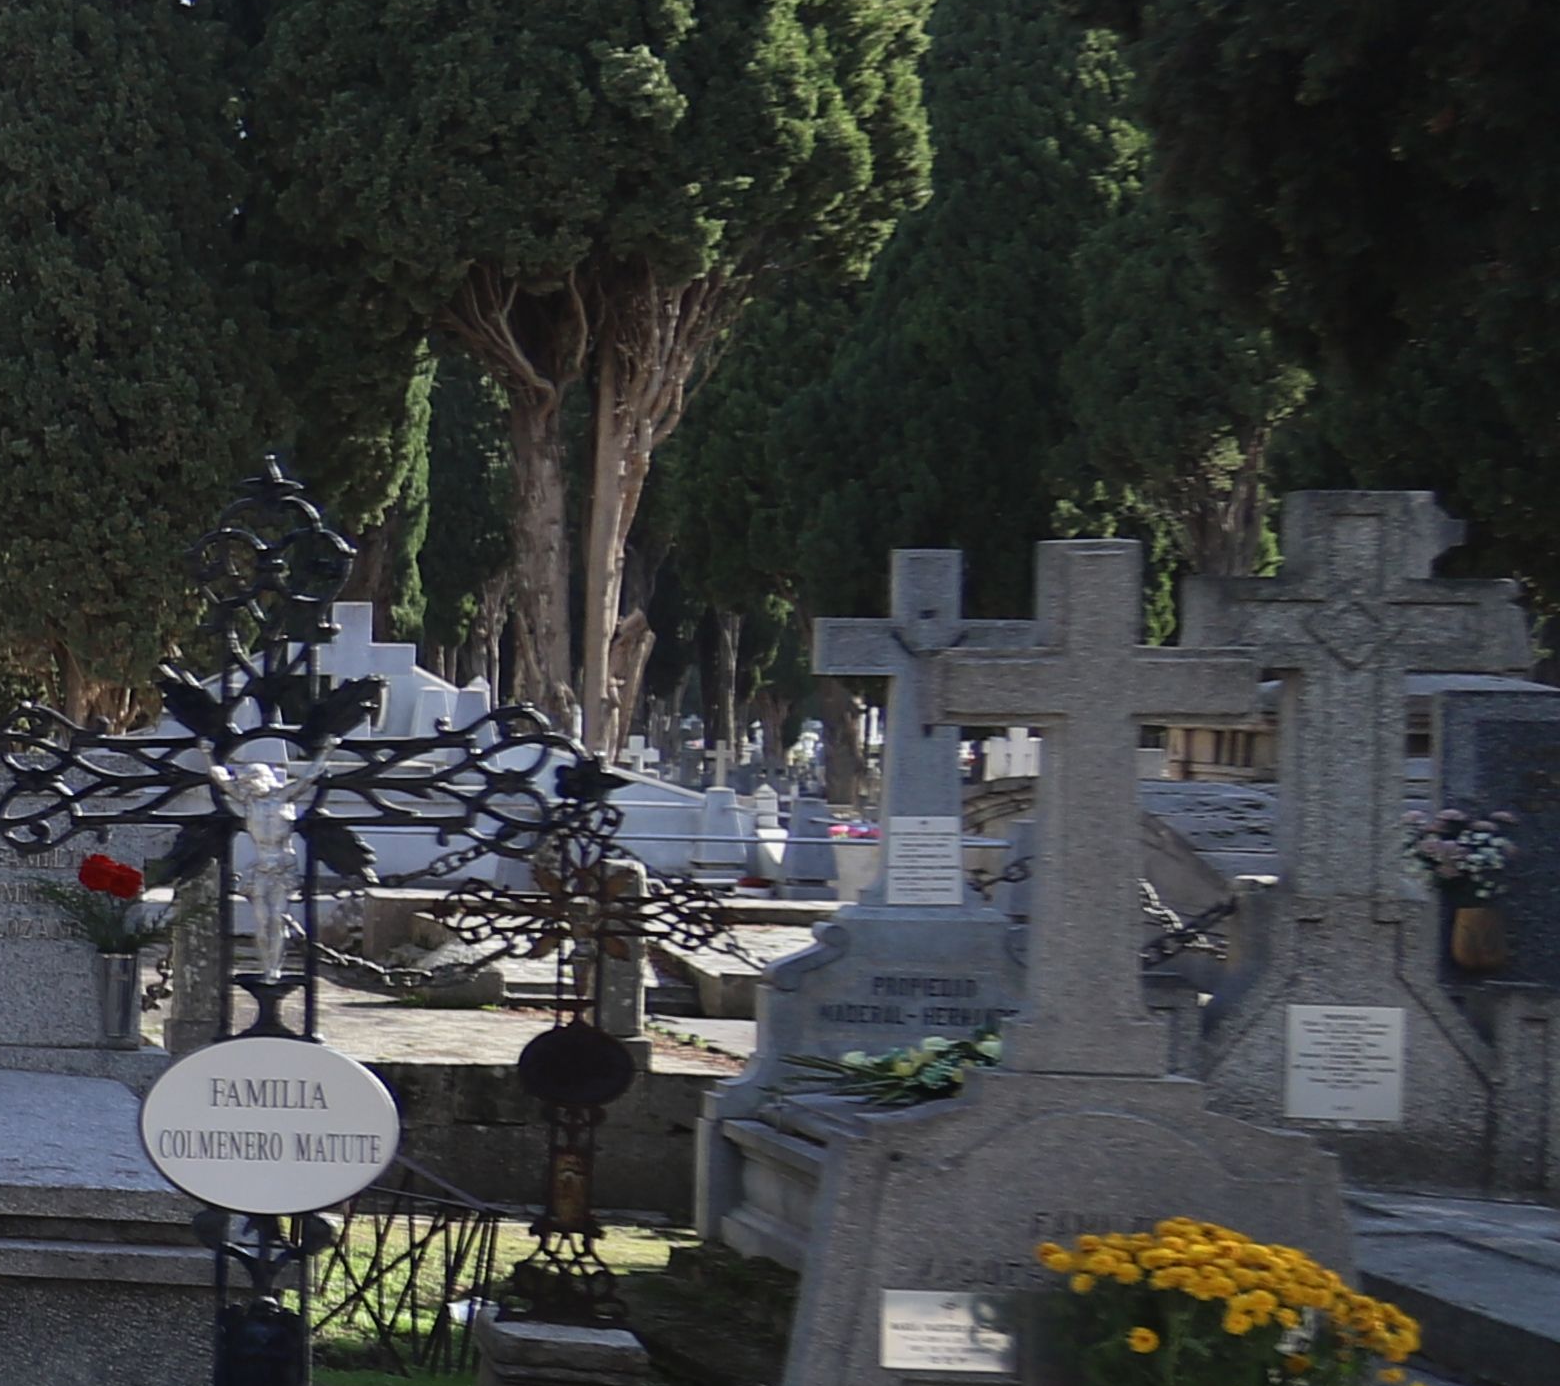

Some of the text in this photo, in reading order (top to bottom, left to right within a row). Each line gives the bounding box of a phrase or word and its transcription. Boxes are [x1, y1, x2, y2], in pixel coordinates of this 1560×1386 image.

[209, 1078, 329, 1110] FAMILIA
[159, 1129, 382, 1165] COLMENERO MATUTE
